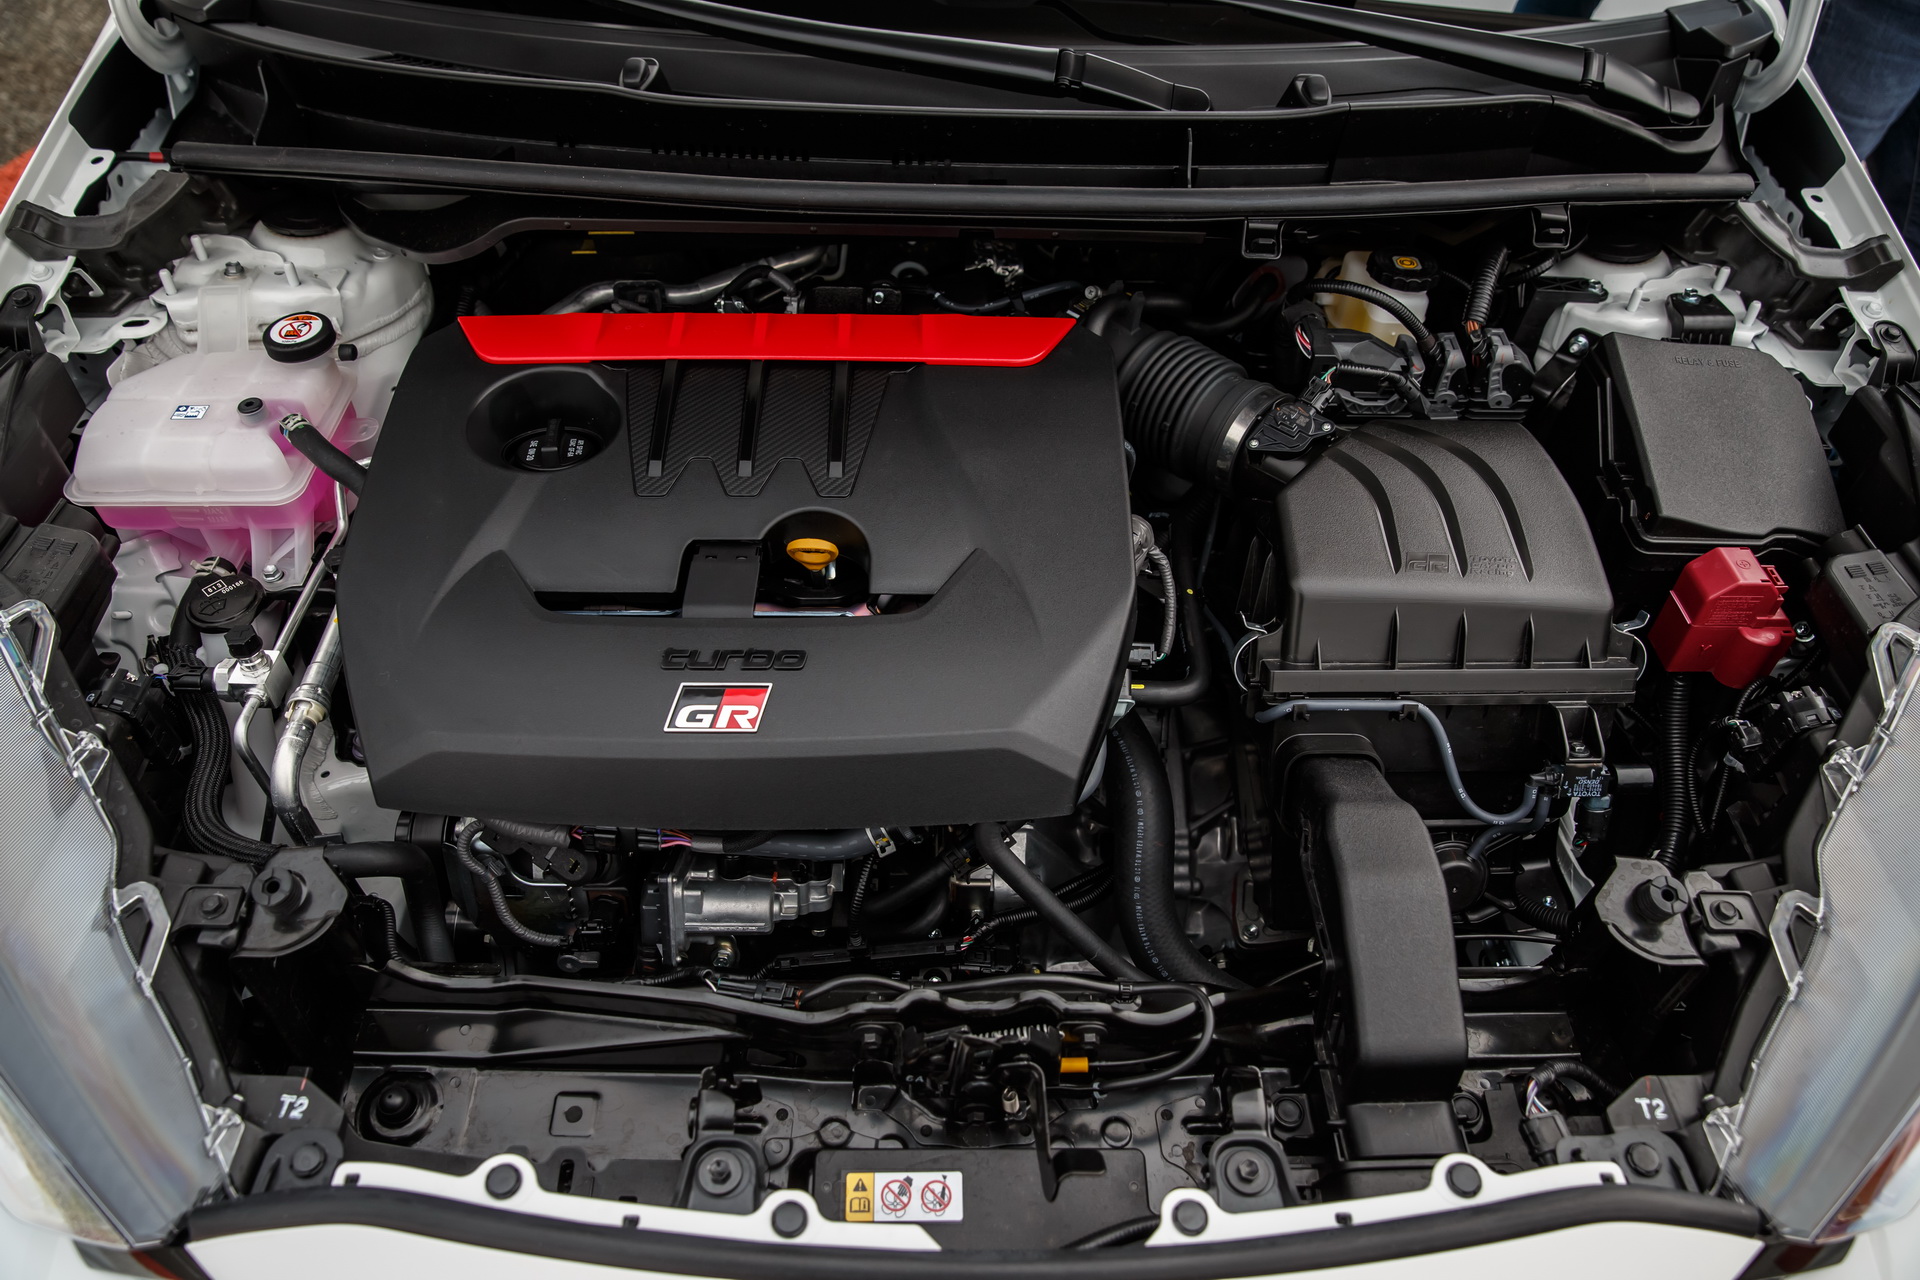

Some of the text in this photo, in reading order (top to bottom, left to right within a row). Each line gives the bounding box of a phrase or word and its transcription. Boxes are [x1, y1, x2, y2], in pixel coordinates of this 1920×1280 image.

[1675, 356, 1703, 366] RELAY
[1716, 359, 1742, 369] FUSE
[660, 647, 808, 671] turbo
[674, 704, 760, 729] GR
[278, 1093, 309, 1120] T2
[1634, 1097, 1668, 1120] T2
